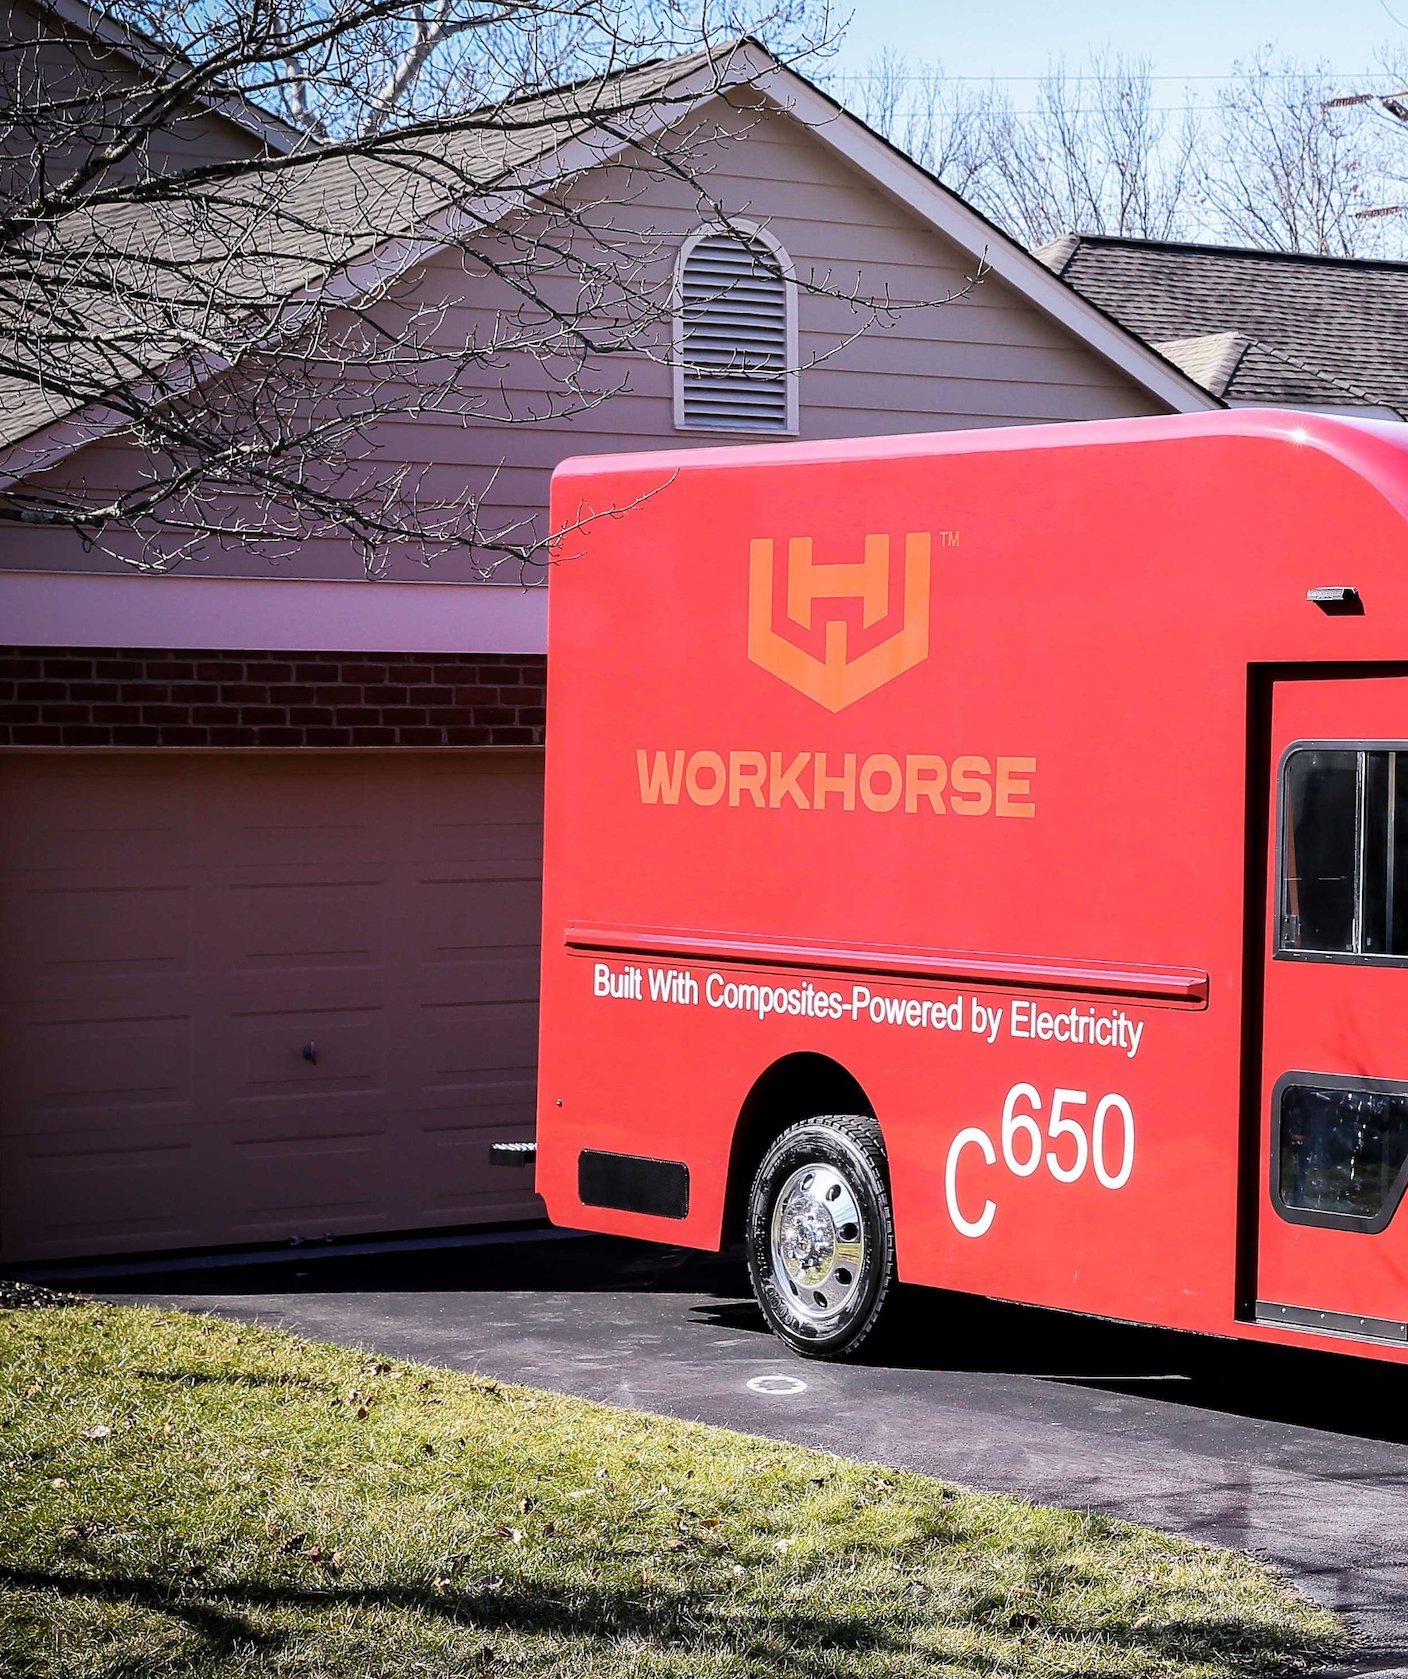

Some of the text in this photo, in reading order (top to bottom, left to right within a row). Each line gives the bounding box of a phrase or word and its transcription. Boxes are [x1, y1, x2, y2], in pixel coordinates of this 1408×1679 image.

[939, 530, 960, 547] TM
[636, 749, 1037, 818] WORKHORSE
[593, 963, 643, 1001] Built
[647, 967, 699, 1006] With
[971, 996, 1003, 1044] by
[1010, 1000, 1144, 1059] Electricity
